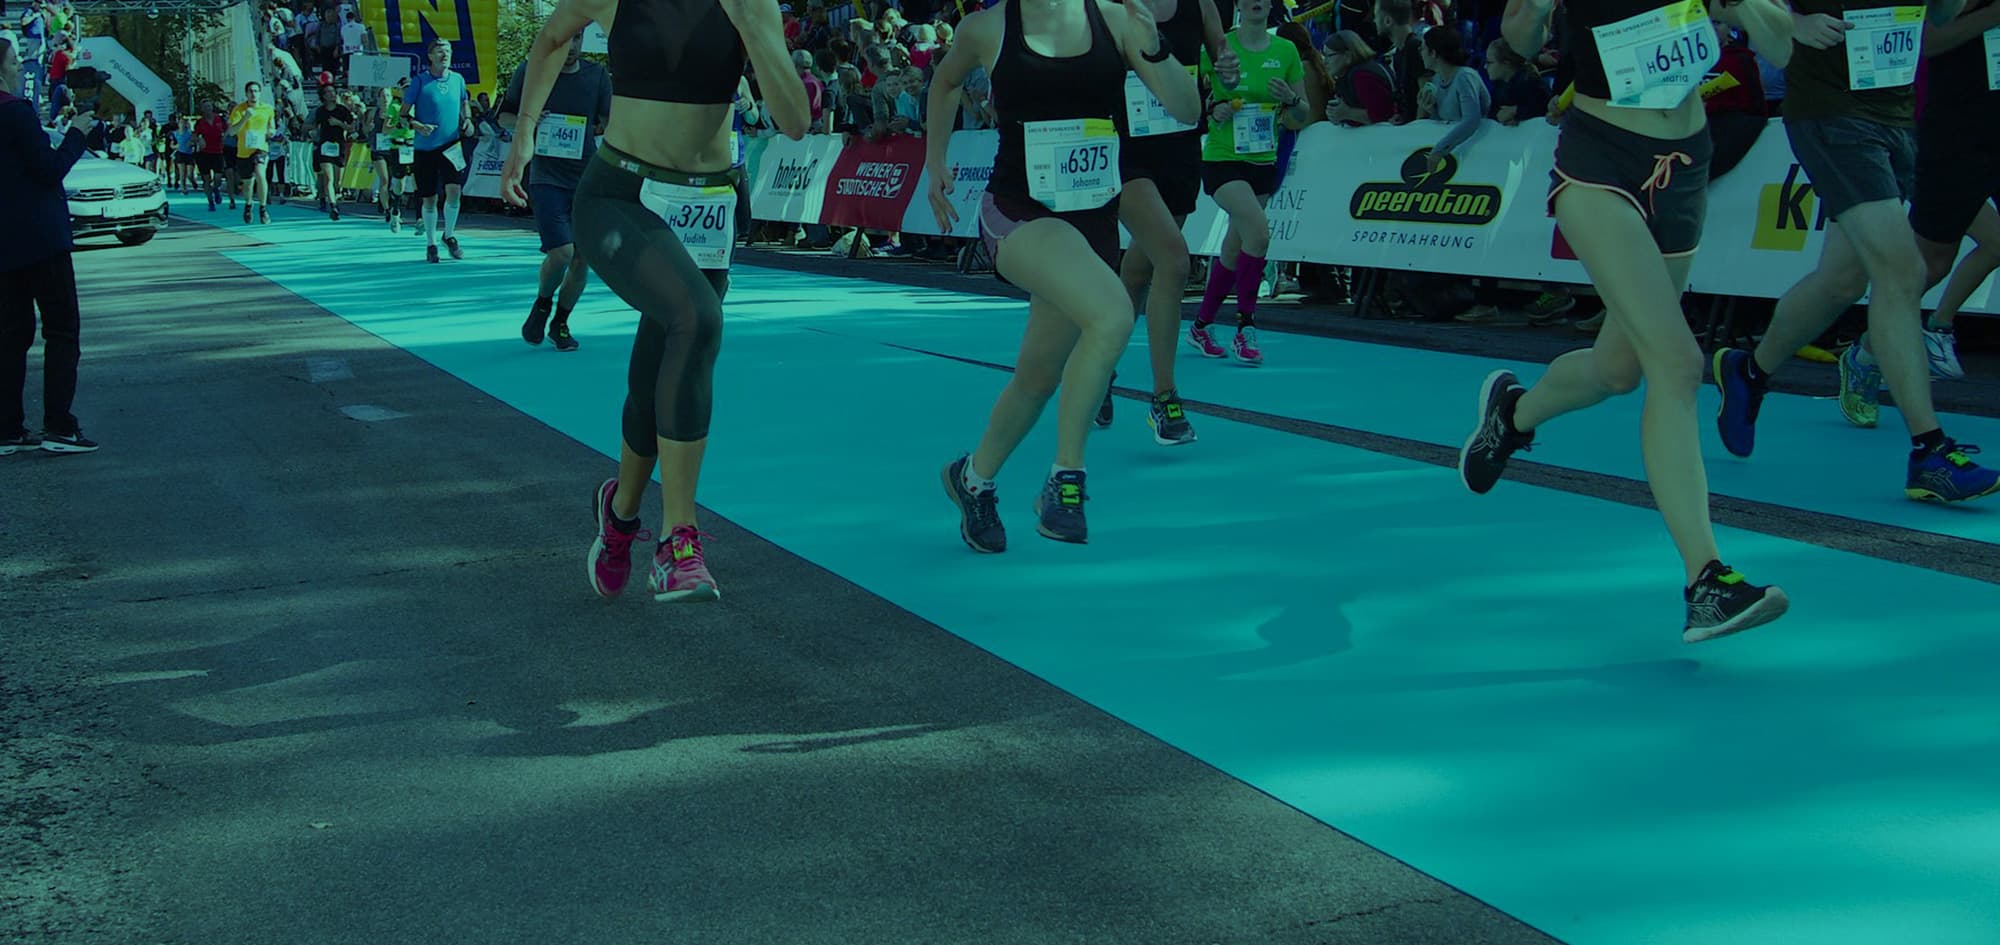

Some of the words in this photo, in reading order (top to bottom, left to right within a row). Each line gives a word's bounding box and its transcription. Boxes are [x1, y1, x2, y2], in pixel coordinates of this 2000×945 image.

[1646, 31, 1708, 75] H6416
[1876, 30, 1913, 55] H6776
[855, 161, 894, 179] WIENER
[1060, 145, 1109, 175] H6375
[1072, 177, 1101, 189] Johanna
[1355, 188, 1491, 217] peeroton
[668, 204, 727, 231] H3760
[682, 233, 706, 244] Judith
[1351, 230, 1475, 249] SPORTNAHRUNG
